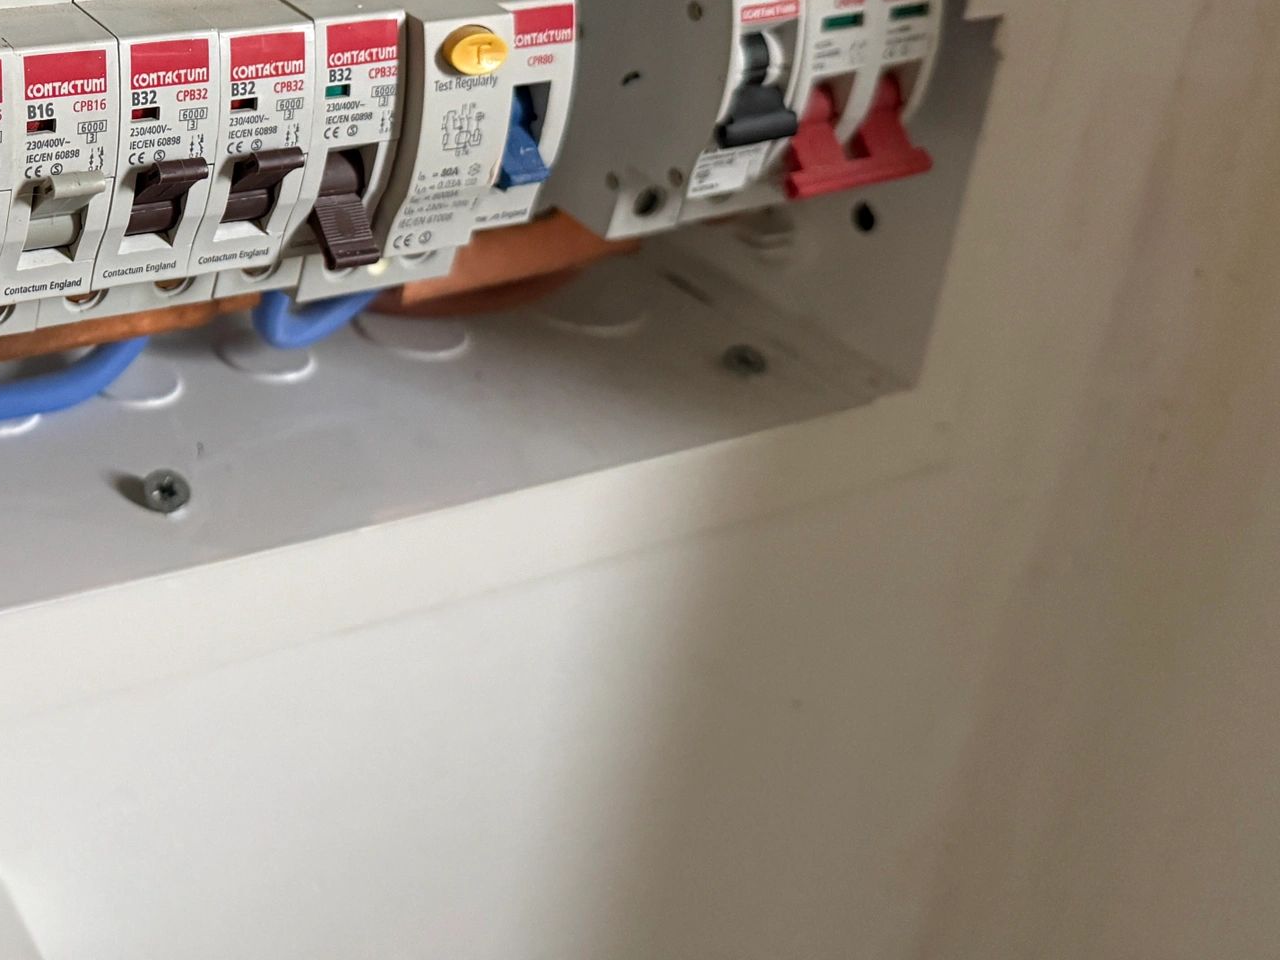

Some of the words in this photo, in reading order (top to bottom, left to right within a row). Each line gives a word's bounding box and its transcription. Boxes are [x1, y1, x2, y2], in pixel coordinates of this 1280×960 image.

[515, 28, 571, 46] ONTACTUM
[329, 45, 397, 66] CONTACTUM
[527, 53, 554, 67] CPR80
[133, 67, 207, 88] CONTACTUM
[232, 59, 304, 80] CONTACTUM
[329, 67, 352, 82] B32
[368, 66, 397, 79] CPB32
[27, 77, 105, 98] CONTACTUM
[231, 81, 255, 97] B32
[274, 79, 304, 94] CPB32
[434, 79, 452, 92] Test
[455, 74, 498, 90] Regularly
[131, 90, 157, 107] B32
[176, 88, 208, 103] CPB32
[279, 98, 301, 109] 6000
[27, 102, 55, 119] B16
[73, 98, 107, 113] CPB16
[182, 109, 205, 119] 6000
[81, 121, 104, 132] 6000
[228, 128, 253, 140] IEC/EN
[254, 125, 278, 136] 60898
[129, 138, 155, 151] IEC/EN
[156, 136, 181, 147] 60898
[25, 152, 53, 164] IEC/EN
[54, 148, 80, 160] 60898
[198, 252, 237, 265] Contactum
[238, 247, 269, 259] England
[102, 266, 144, 279] Contactum
[145, 260, 177, 273] England
[3, 283, 48, 297] Contactum
[49, 277, 82, 291] England
